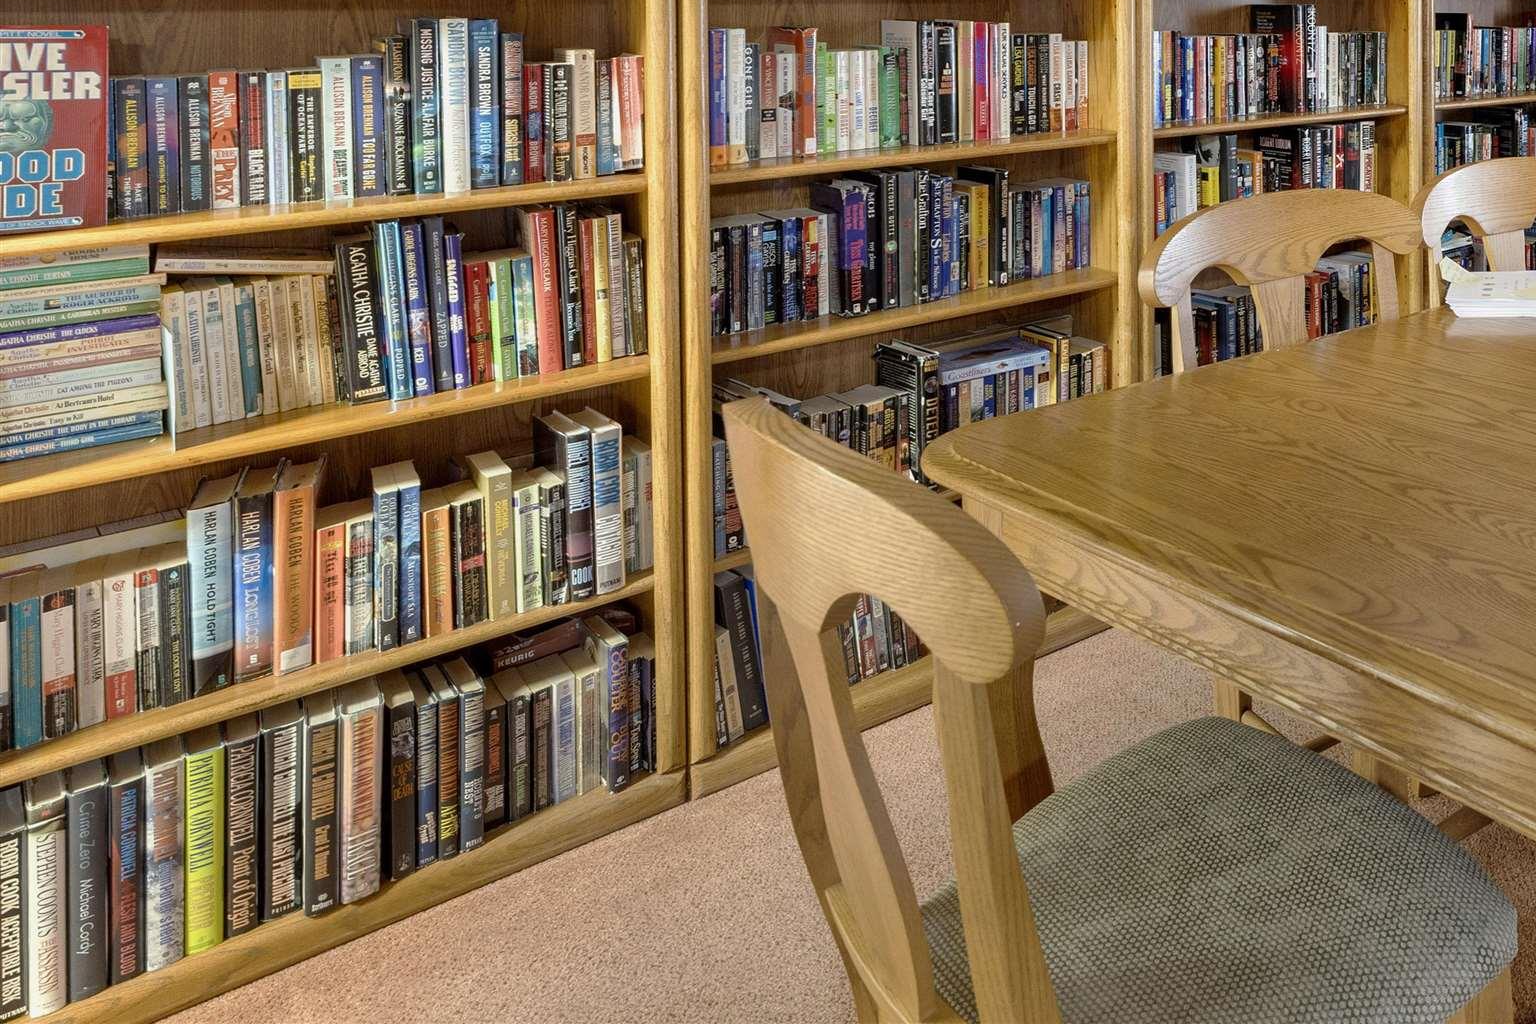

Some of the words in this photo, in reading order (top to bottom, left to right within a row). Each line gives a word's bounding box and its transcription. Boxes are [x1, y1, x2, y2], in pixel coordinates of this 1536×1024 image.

[420, 28, 434, 65] MISSING
[478, 46, 492, 82] SANDRA
[744, 47, 753, 81] GONE
[298, 94, 306, 105] OF
[332, 77, 345, 109] ALLISON
[361, 75, 374, 104] ALLISON
[421, 66, 434, 100] JUSTICE
[478, 83, 493, 116] BROWN
[744, 85, 753, 112] GIRL
[1027, 86, 1036, 110] TOUCH
[125, 99, 137, 133] ALLISON
[189, 98, 201, 128] ALLISON
[298, 107, 306, 133] OCEAN
[306, 97, 314, 113] THE
[362, 104, 375, 137] BRENNAN
[392, 102, 406, 136] SUZANNE
[421, 102, 435, 138] ALAFAIR
[1028, 115, 1036, 125] GO
[189, 128, 202, 161] BRENNAN
[298, 134, 307, 154] PARK
[306, 114, 315, 150] EMPEROR
[333, 111, 346, 148] BRENNAN
[362, 137, 376, 154] TOO
[479, 121, 493, 157] OUTFOX
[504, 118, 522, 147] smash
[126, 133, 139, 169] BRENNAN
[248, 149, 264, 175] BLACK
[362, 154, 376, 170] FAR
[393, 136, 407, 182] BROCKMANN
[423, 139, 436, 168] BURKE
[504, 147, 522, 162] cut
[123, 176, 132, 197] THEM
[134, 182, 143, 203] MAKE
[191, 165, 203, 201] NOTORIOUS
[213, 158, 238, 204] PREY
[249, 176, 265, 201] RAIN
[362, 170, 377, 191] GONE
[918, 175, 929, 193] Sue
[124, 197, 133, 211] PAY
[918, 193, 929, 229] Grafton
[540, 216, 550, 240] MARY
[563, 210, 579, 233] Mary
[349, 246, 370, 289] AGATHA
[541, 240, 551, 268] HIGGINS
[563, 235, 580, 268] Higgins
[542, 268, 553, 292] CLARK
[567, 269, 581, 294] Clark
[352, 289, 375, 338] CHRISTIE
[436, 311, 449, 348] ZAPPED
[366, 337, 378, 357] DAME
[357, 349, 370, 379] ABROAD
[369, 358, 382, 386] AGATHA
[594, 438, 621, 474] ROBIN
[595, 475, 621, 508] COOK
[203, 511, 218, 547] HARLAN
[241, 511, 260, 551] HARLAN
[597, 513, 623, 567] CONTAGION
[204, 547, 218, 579] COBEN
[242, 553, 262, 585] COBEN
[571, 565, 594, 587] COOK
[205, 582, 217, 610] HOLD
[206, 612, 218, 643] TIGHT
[498, 649, 536, 668] KEURIG
[272, 726, 298, 772] PATRICIA
[189, 755, 215, 810] PATRICIA
[230, 743, 256, 793] PATRICIA
[120, 788, 137, 831] PATRICIA
[272, 772, 297, 822] CORNWELL
[79, 801, 96, 837] Crime
[229, 792, 255, 846] CORNWELL
[271, 818, 296, 838] THE
[0, 837, 20, 878] ROBIN
[79, 841, 96, 870] Zero
[120, 831, 137, 882] CORNWELL
[189, 810, 214, 873] CORNWELL
[271, 836, 296, 862] LAST
[35, 832, 58, 889] STEPHEN
[231, 846, 257, 877] Point
[1, 878, 21, 914] COOK
[79, 878, 96, 921] Michael
[233, 878, 255, 890] of
[271, 861, 296, 907] PRECINCT
[35, 888, 58, 938] COONTS
[120, 895, 137, 920] FLESH
[228, 890, 256, 930] Origin
[1, 914, 22, 976] ACCEPTABLE
[75, 921, 95, 955] Cordy
[120, 921, 137, 944] AND
[38, 946, 59, 996] ASSASSIN
[120, 944, 137, 975] BLOOD
[1, 976, 22, 1005] RISK
